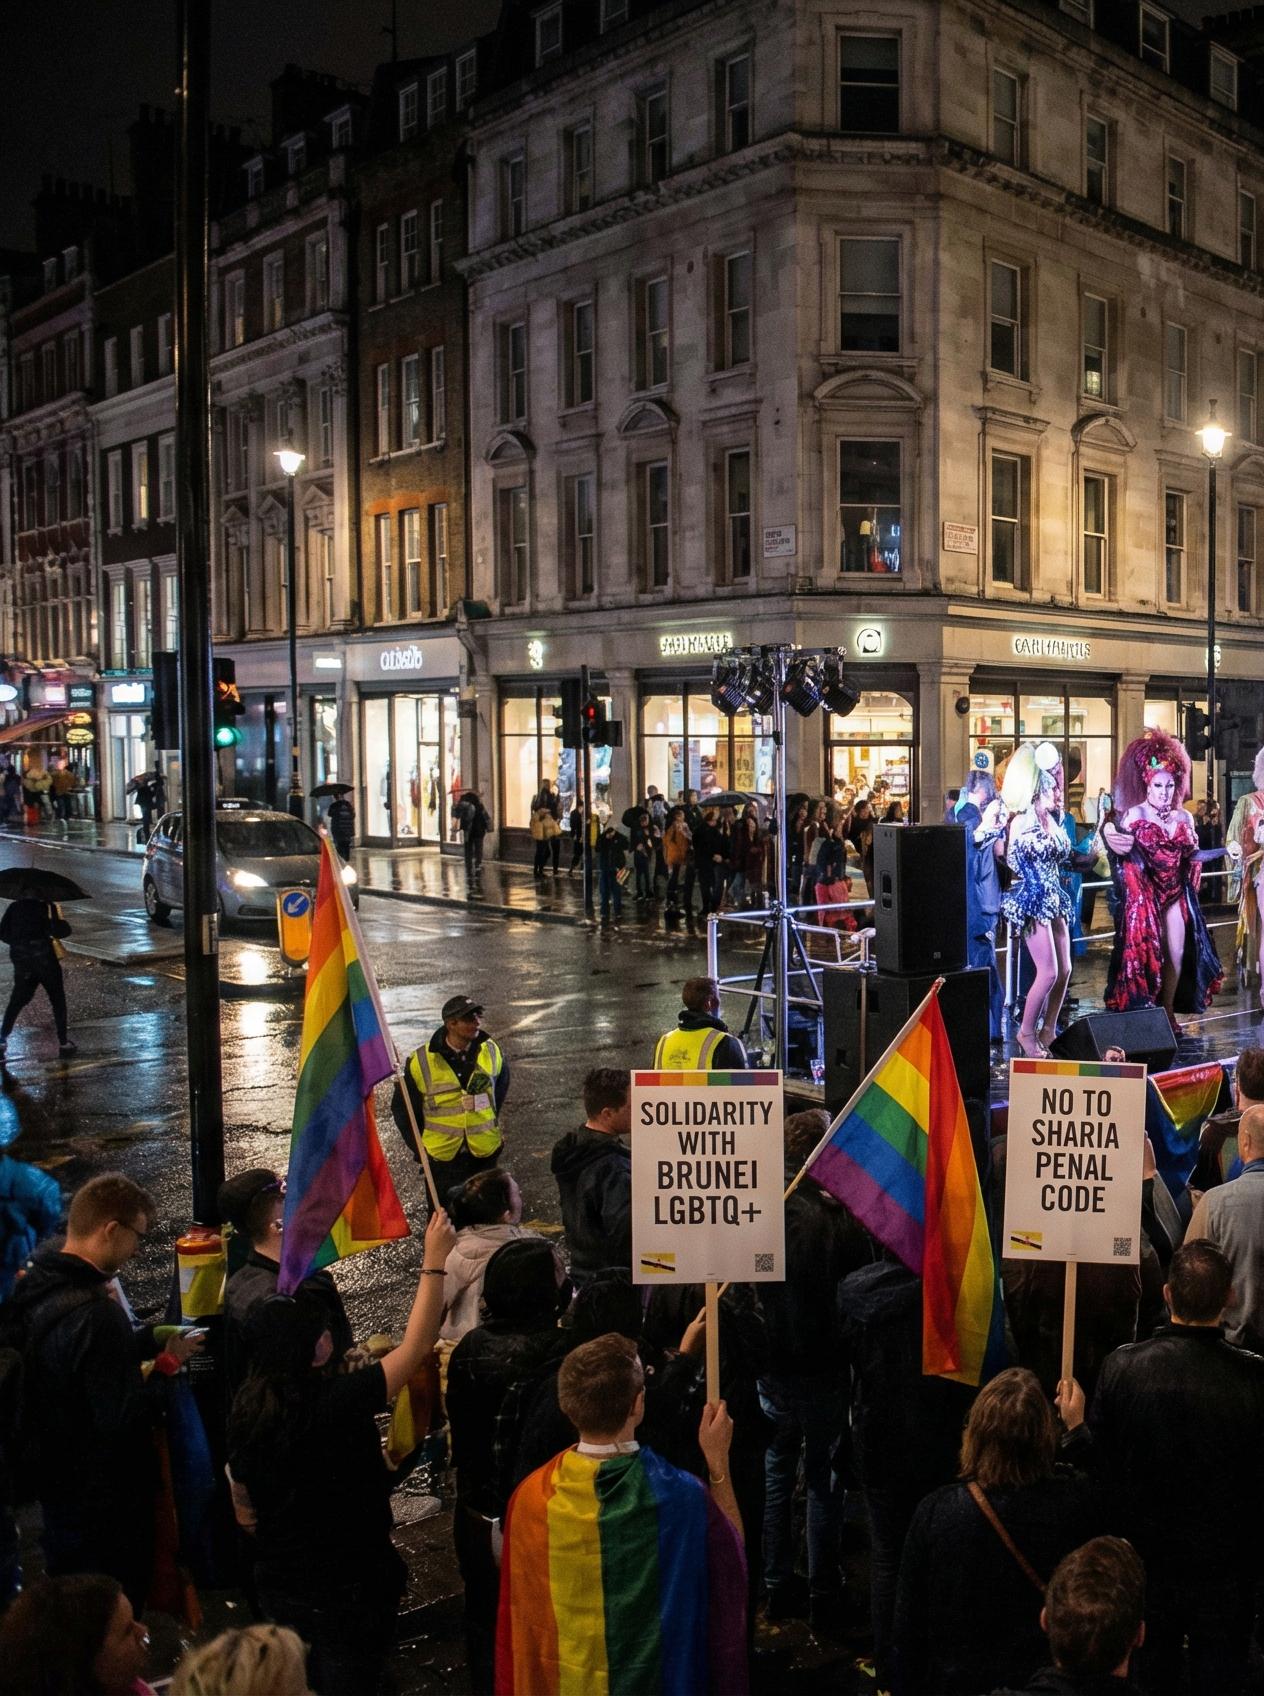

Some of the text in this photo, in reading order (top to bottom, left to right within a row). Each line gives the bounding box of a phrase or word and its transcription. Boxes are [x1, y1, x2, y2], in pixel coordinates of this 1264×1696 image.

[641, 1101, 773, 1126] SOLIDARITY
[1042, 1088, 1111, 1117] NO TO
[678, 1131, 735, 1155] WITH
[1032, 1119, 1119, 1149] SHARIA
[658, 1160, 757, 1189] BRUNEI
[1036, 1152, 1113, 1181] PENAL
[655, 1195, 761, 1226] LGBTQ+
[1042, 1184, 1105, 1212] CODE
